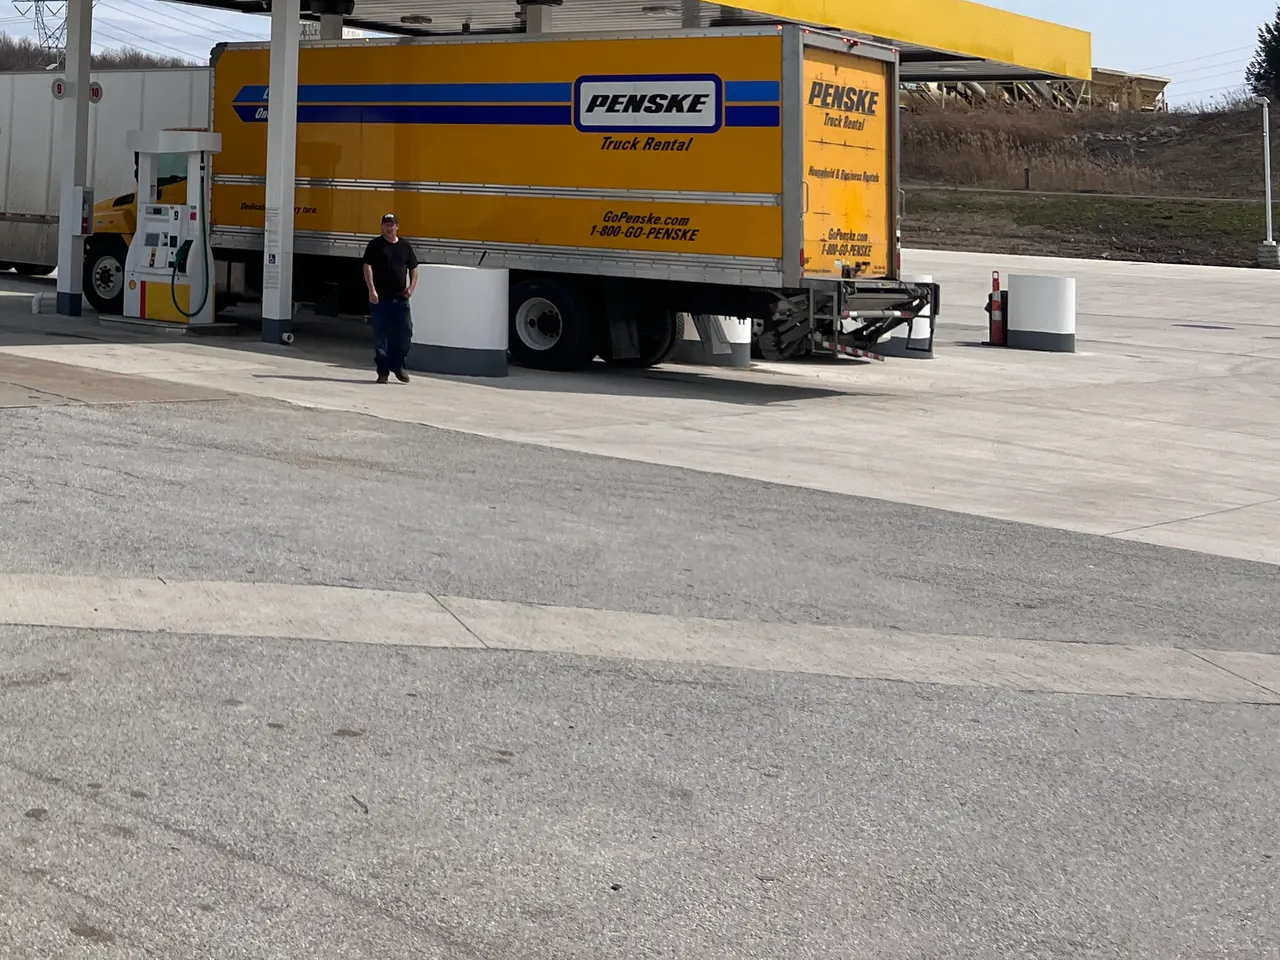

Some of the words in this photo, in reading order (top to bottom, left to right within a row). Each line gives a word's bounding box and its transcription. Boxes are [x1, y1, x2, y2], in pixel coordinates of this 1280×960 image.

[56, 83, 62, 94] 9
[91, 87, 100, 98] 10
[585, 94, 710, 114] PENSKE
[808, 81, 879, 114] PENSKE
[823, 112, 842, 128] Truck
[843, 115, 865, 131] Rental
[600, 136, 640, 151] Truck
[642, 137, 693, 151] Rental
[808, 165, 835, 179] Household
[835, 168, 840, 179] &
[840, 168, 862, 181] Business
[862, 171, 879, 183] Rentals
[174, 210, 179, 221] 9
[602, 210, 690, 226] GoPenske.com
[590, 224, 699, 241] 1-800-GO-PENSKE
[828, 227, 868, 242] GoPenske.com
[821, 243, 872, 257] 1-800-GO-PENSKE
